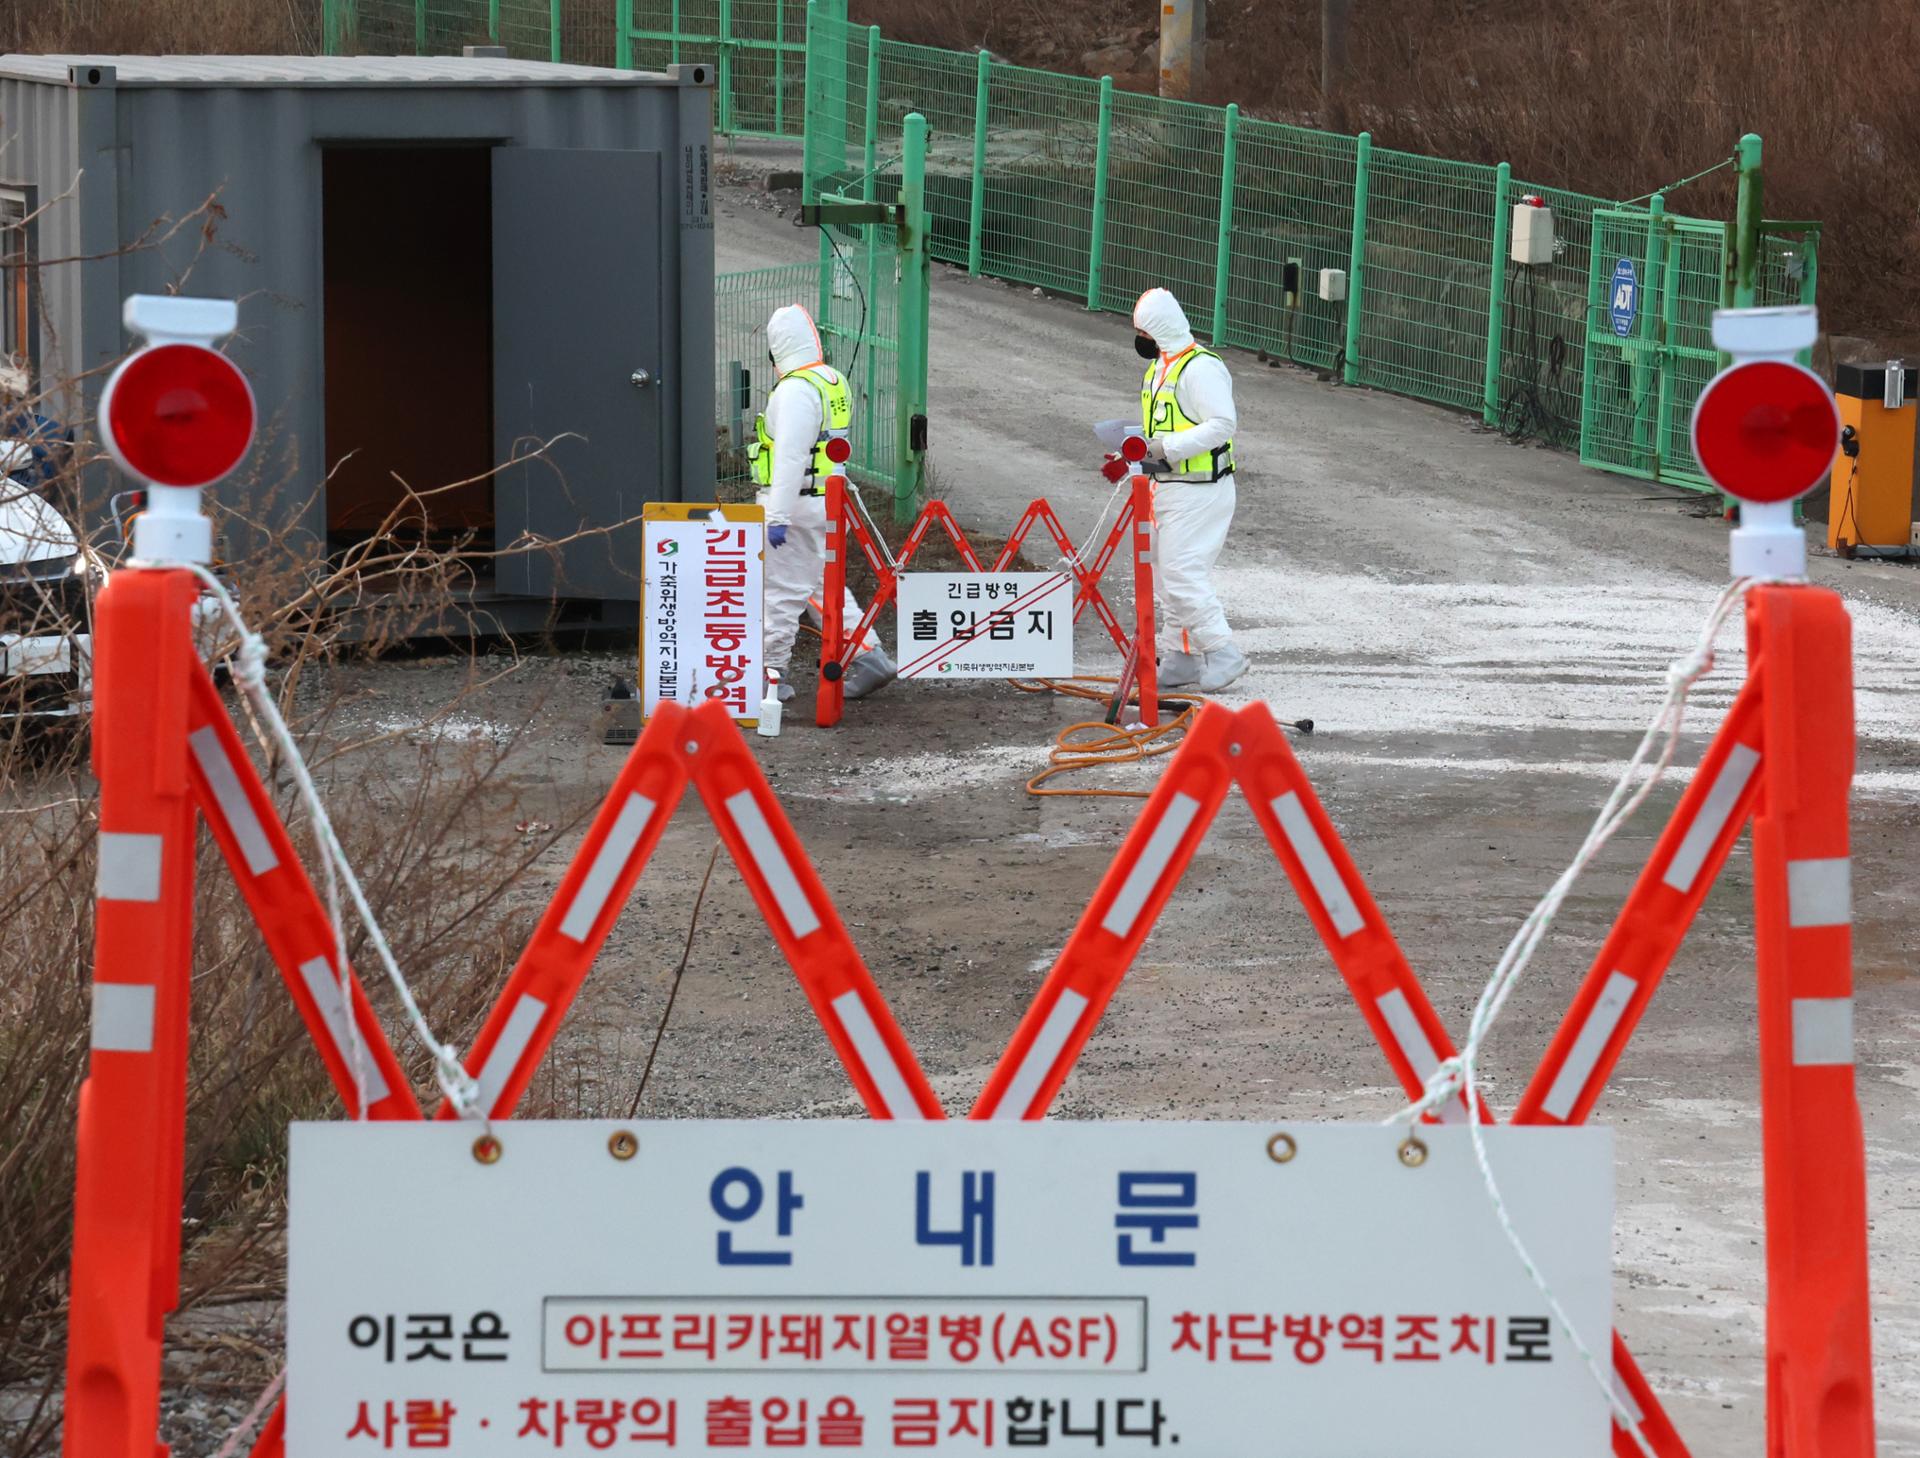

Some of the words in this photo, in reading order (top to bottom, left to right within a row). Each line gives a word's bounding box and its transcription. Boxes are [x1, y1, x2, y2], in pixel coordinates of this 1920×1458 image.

[1614, 284, 1633, 311] ADT
[947, 582, 1018, 600] 긴급방역
[703, 529, 751, 714] 긴급초동방역
[912, 609, 1053, 641] 출입금지
[347, 1311, 510, 1363] 이곳은
[564, 1312, 1118, 1364] 아프리카돼지열병(ASF)
[1171, 1311, 1553, 1364] 차단방역조치로
[346, 1399, 457, 1450] 사람
[517, 1397, 677, 1450] 차량의
[705, 1396, 864, 1448] 출입을
[891, 1396, 1180, 1448] 금지합니다.
